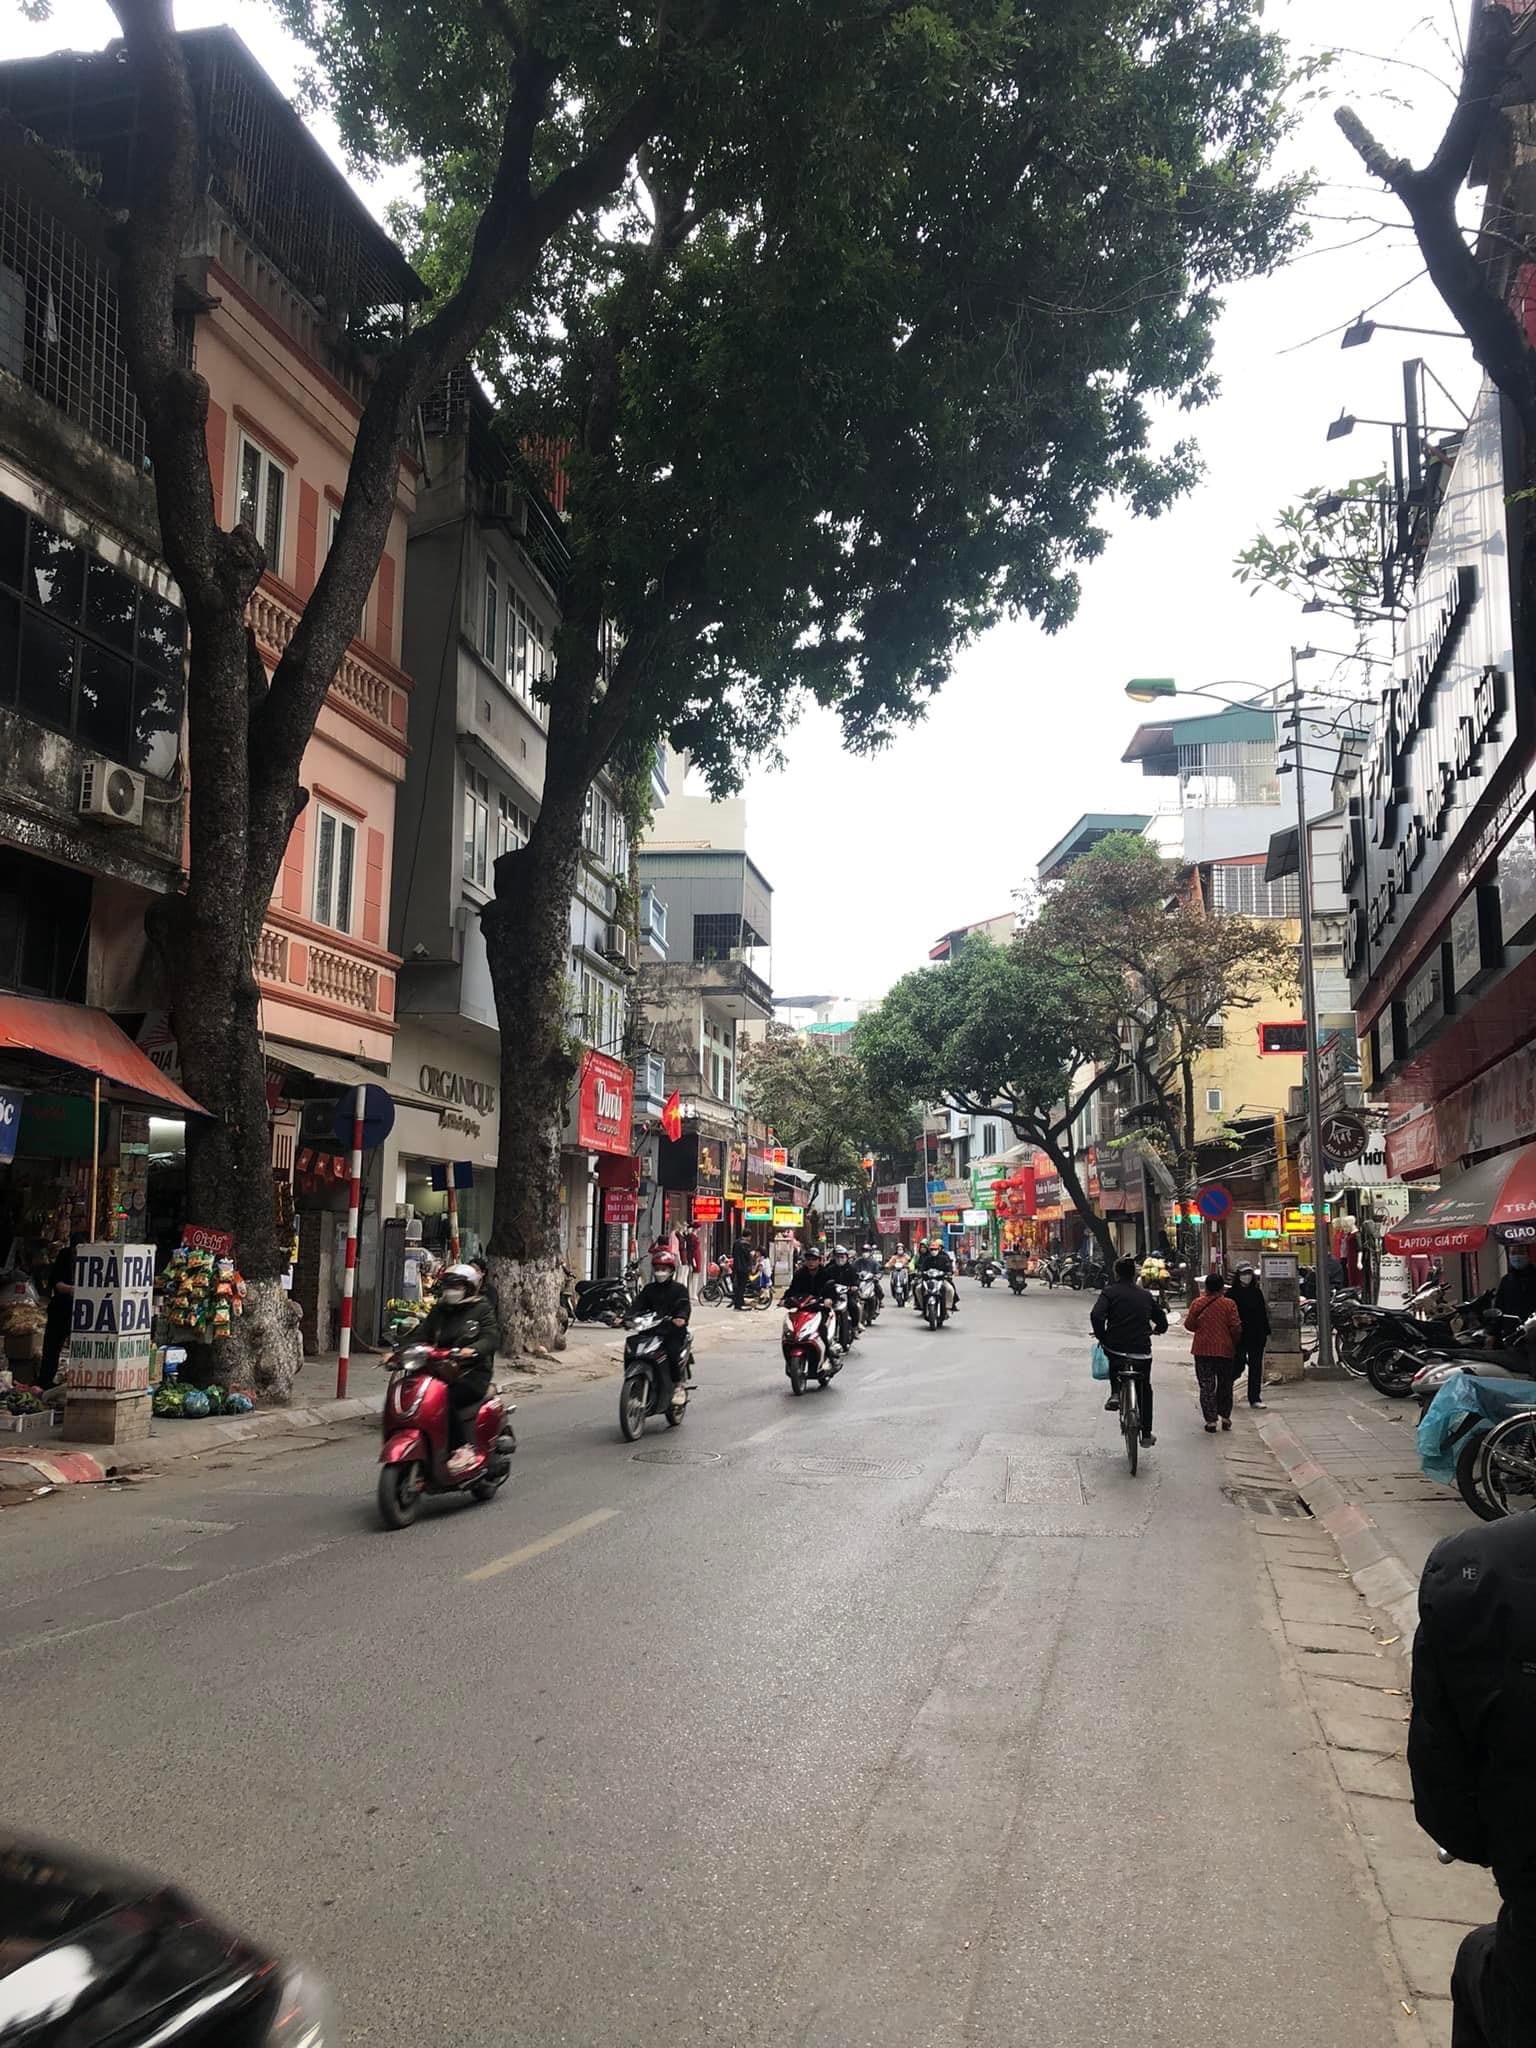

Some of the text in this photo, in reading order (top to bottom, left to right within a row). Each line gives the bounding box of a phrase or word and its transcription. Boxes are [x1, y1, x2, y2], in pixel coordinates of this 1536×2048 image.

[419, 1065, 496, 1117] ORGANIQUE
[193, 1230, 225, 1250] Oishi
[1399, 1236, 1432, 1249] LAPTOP
[1504, 1226, 1535, 1239] GIAO
[74, 1249, 120, 1288] TRÀ
[124, 1249, 153, 1288] TRÀ
[72, 1292, 117, 1332] ĐÁ
[121, 1293, 151, 1331] ĐÁ
